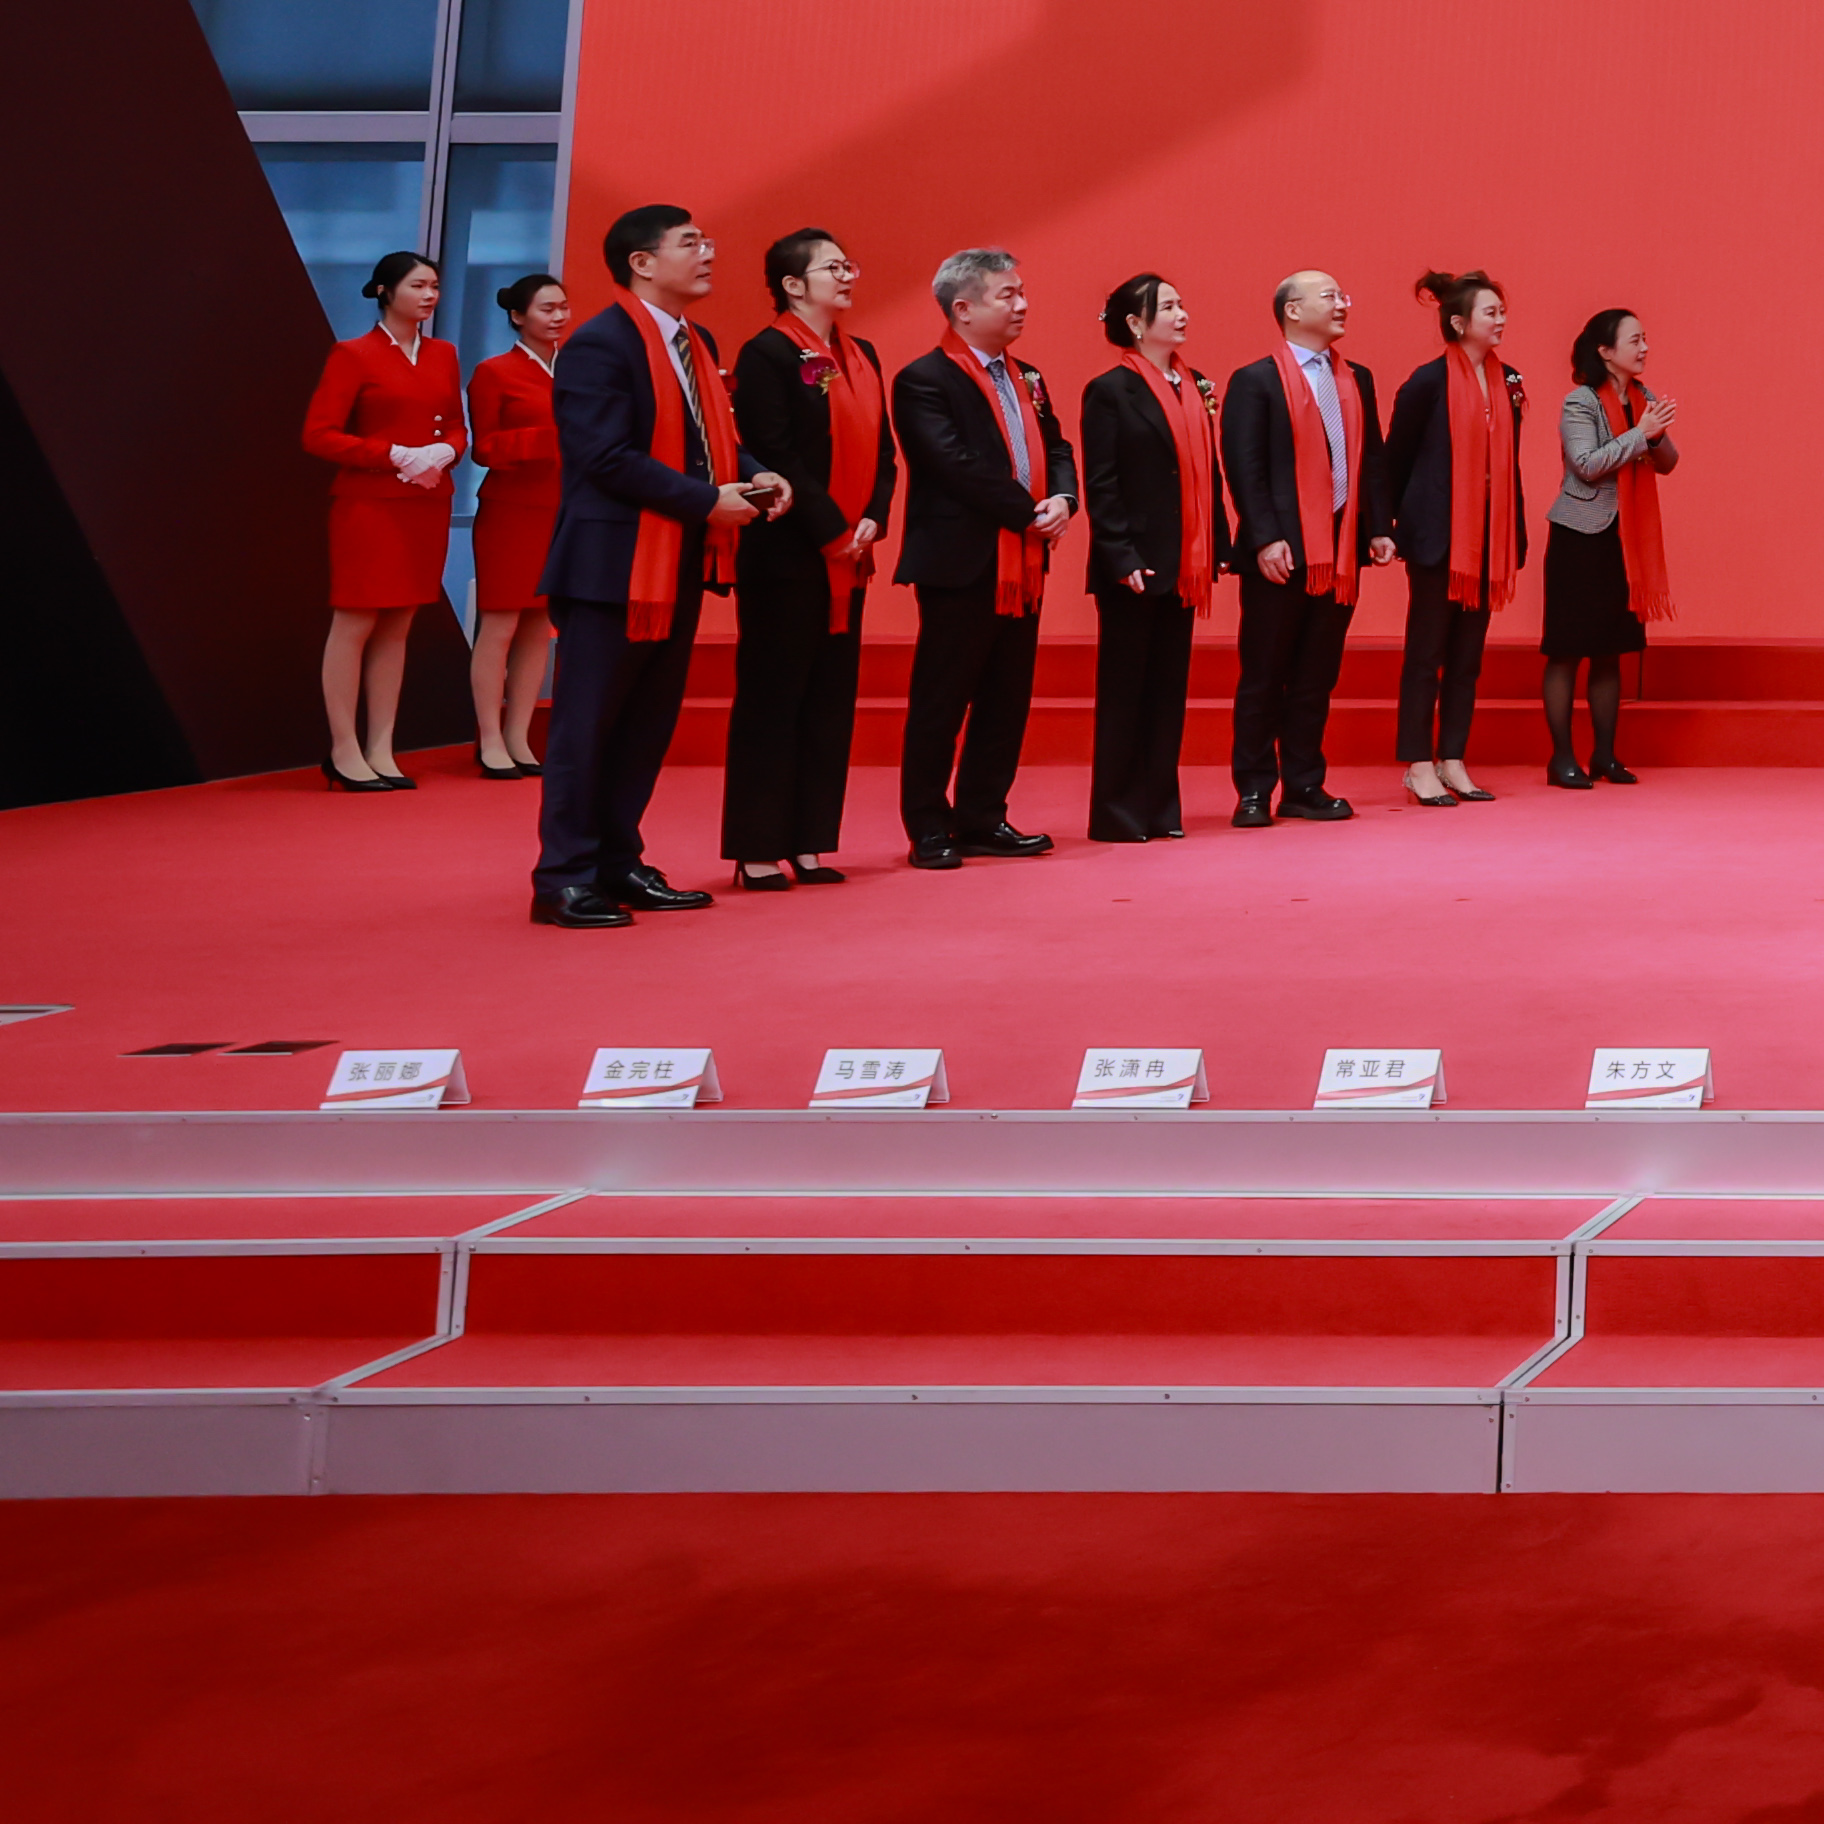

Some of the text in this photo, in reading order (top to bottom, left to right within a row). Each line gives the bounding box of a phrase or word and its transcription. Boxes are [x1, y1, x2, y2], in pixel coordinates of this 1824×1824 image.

[603, 1059, 676, 1080] 金完柱
[834, 1060, 907, 1080] 马雪涛
[1093, 1058, 1166, 1079] 张潇冉
[1335, 1058, 1407, 1079] 常亚君
[1605, 1059, 1677, 1080] 朱方文
